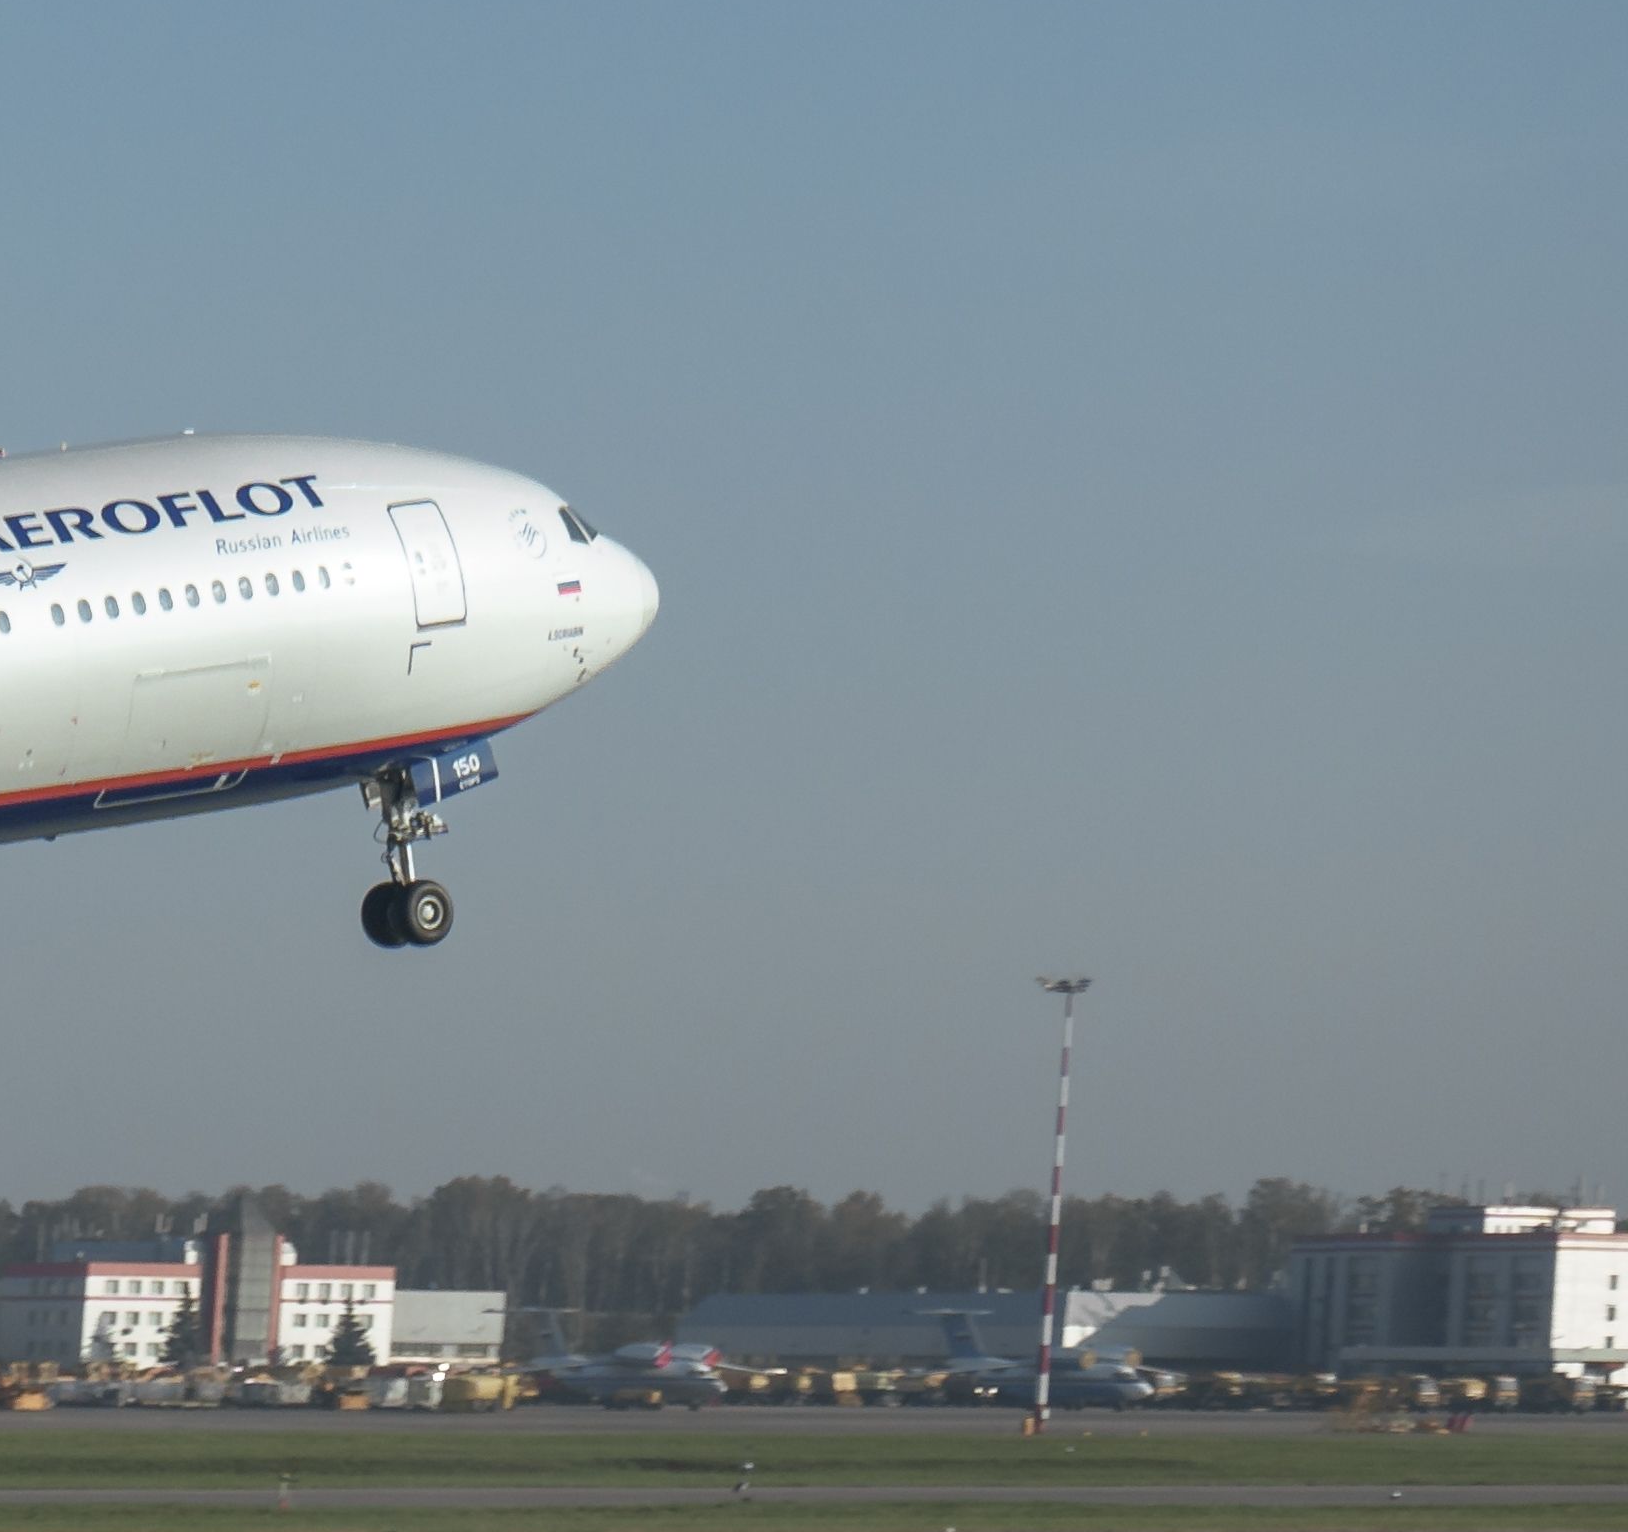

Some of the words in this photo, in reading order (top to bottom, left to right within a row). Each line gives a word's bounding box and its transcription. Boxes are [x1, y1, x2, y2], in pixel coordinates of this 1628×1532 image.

[215, 533, 282, 556] Russian
[291, 524, 350, 544] Airlines
[452, 753, 481, 779] 150
